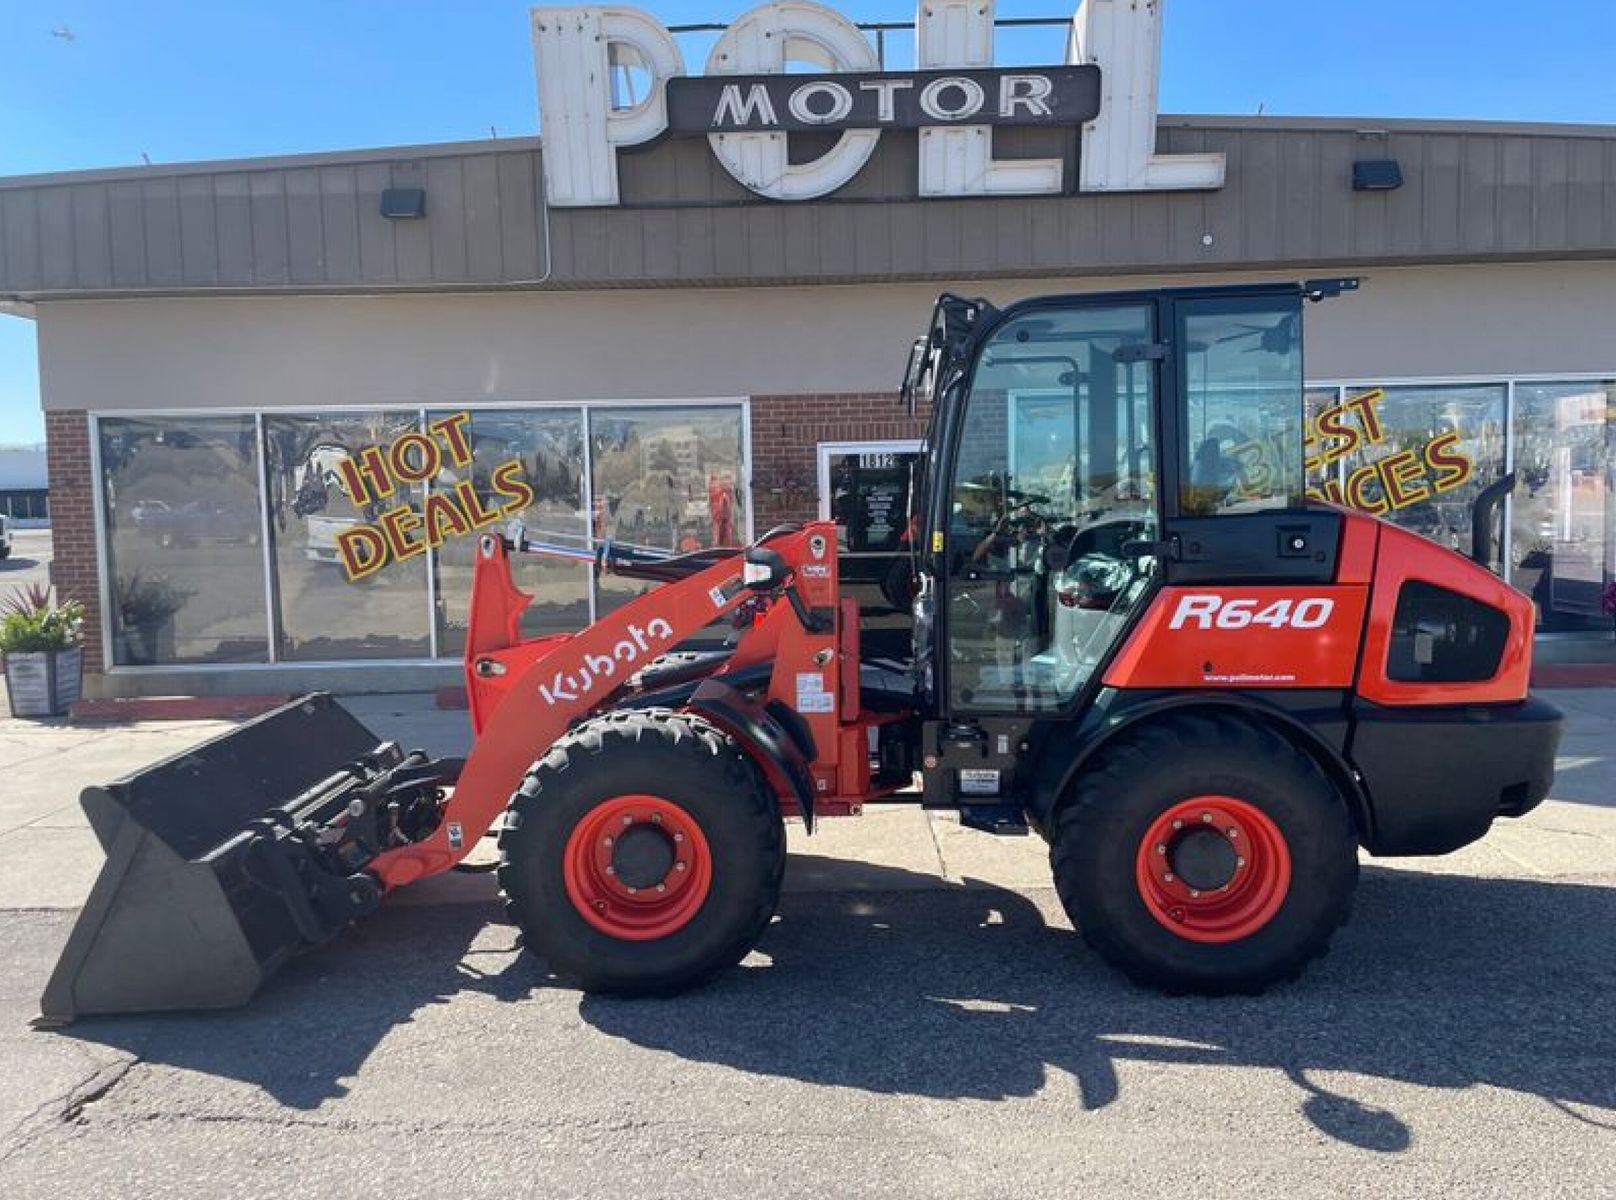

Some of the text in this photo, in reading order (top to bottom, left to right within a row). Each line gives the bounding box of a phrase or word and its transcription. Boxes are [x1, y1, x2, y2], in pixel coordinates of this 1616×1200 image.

[531, 0, 1226, 208] POLL
[711, 73, 1055, 128] MOTOR
[340, 410, 472, 507] HOT
[337, 459, 534, 583] DEALS
[1168, 595, 1335, 630] R640
[538, 618, 673, 705] Kubota
